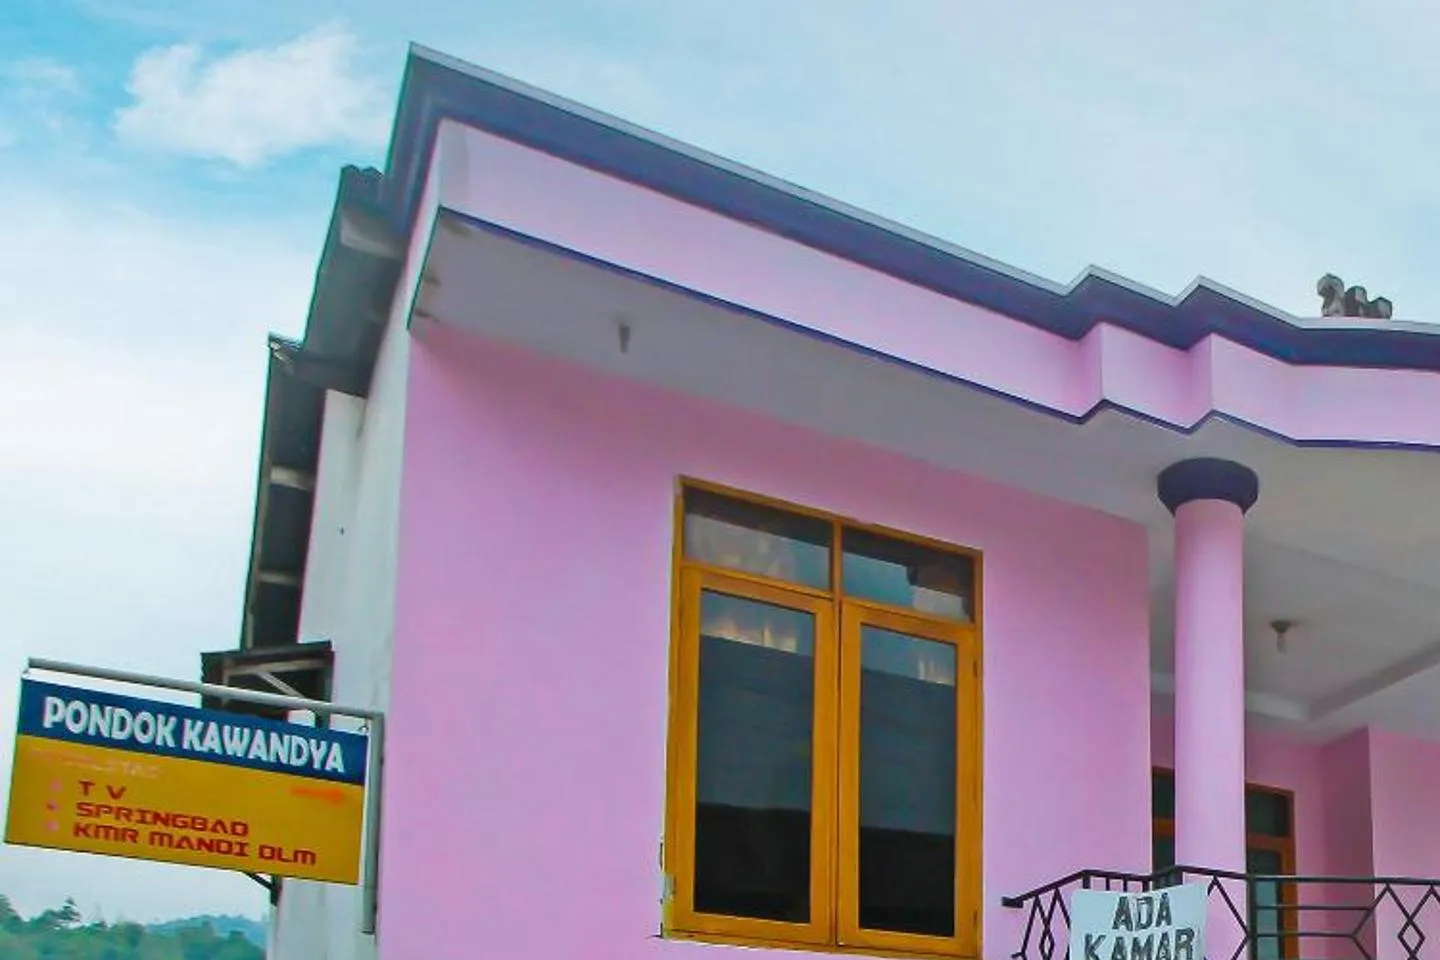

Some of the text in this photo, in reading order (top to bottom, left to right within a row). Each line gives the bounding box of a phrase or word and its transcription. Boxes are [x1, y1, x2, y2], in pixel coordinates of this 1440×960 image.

[42, 696, 178, 749] PONDOK
[182, 718, 346, 773] KAWANDYA
[76, 802, 250, 838] SPRINGBAD
[73, 823, 318, 866] KMR MANDI DLM
[1111, 892, 1173, 932] ADA
